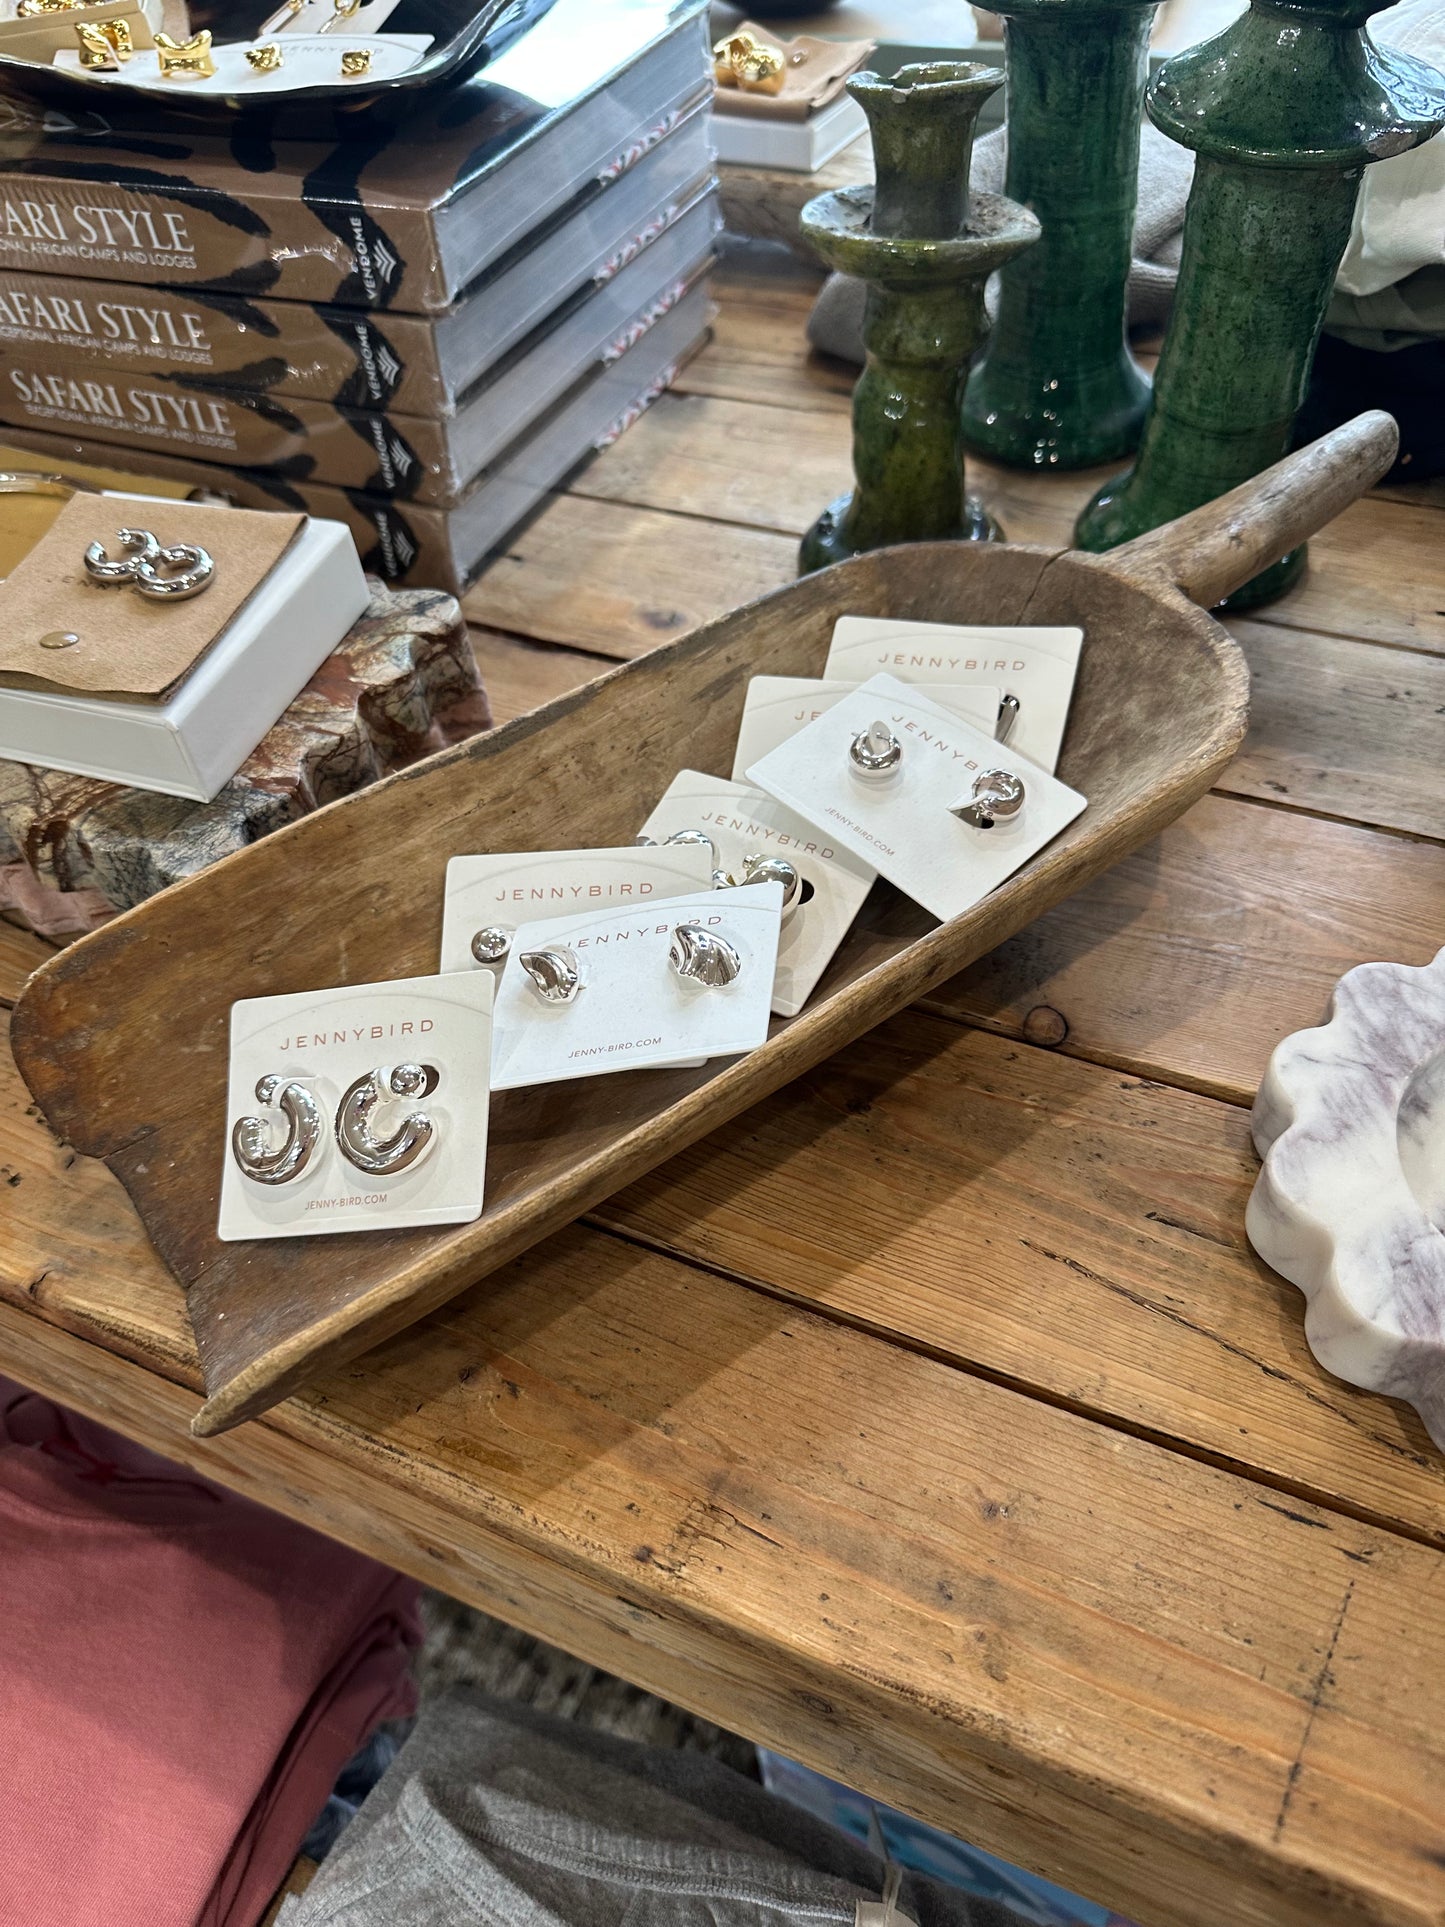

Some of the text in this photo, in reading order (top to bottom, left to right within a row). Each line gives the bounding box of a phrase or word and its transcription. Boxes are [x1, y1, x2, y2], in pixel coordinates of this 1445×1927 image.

[0, 200, 195, 252] ARI STYLE
[122, 251, 148, 264] AND
[149, 253, 198, 269] LODGES
[350, 217, 377, 299] VENDOME
[97, 303, 211, 350] STYLE
[354, 322, 382, 399] VENDOME
[10, 368, 236, 437] SAFARI STYLE
[369, 418, 395, 488] VENDOME
[878, 653, 1026, 671] JENNYBIRD
[892, 716, 979, 771] JENNYB
[701, 812, 834, 859] JENNYBIRD
[825, 807, 896, 856] JENNY-BIRD.COM
[496, 882, 653, 901] JENNYBIRD
[567, 916, 722, 948] ENNYBD
[280, 1019, 434, 1051] JENNYBIRD
[568, 1037, 662, 1058] JENNY-BIRD.COM
[305, 1194, 387, 1210] JENNY-BIRD.COM
